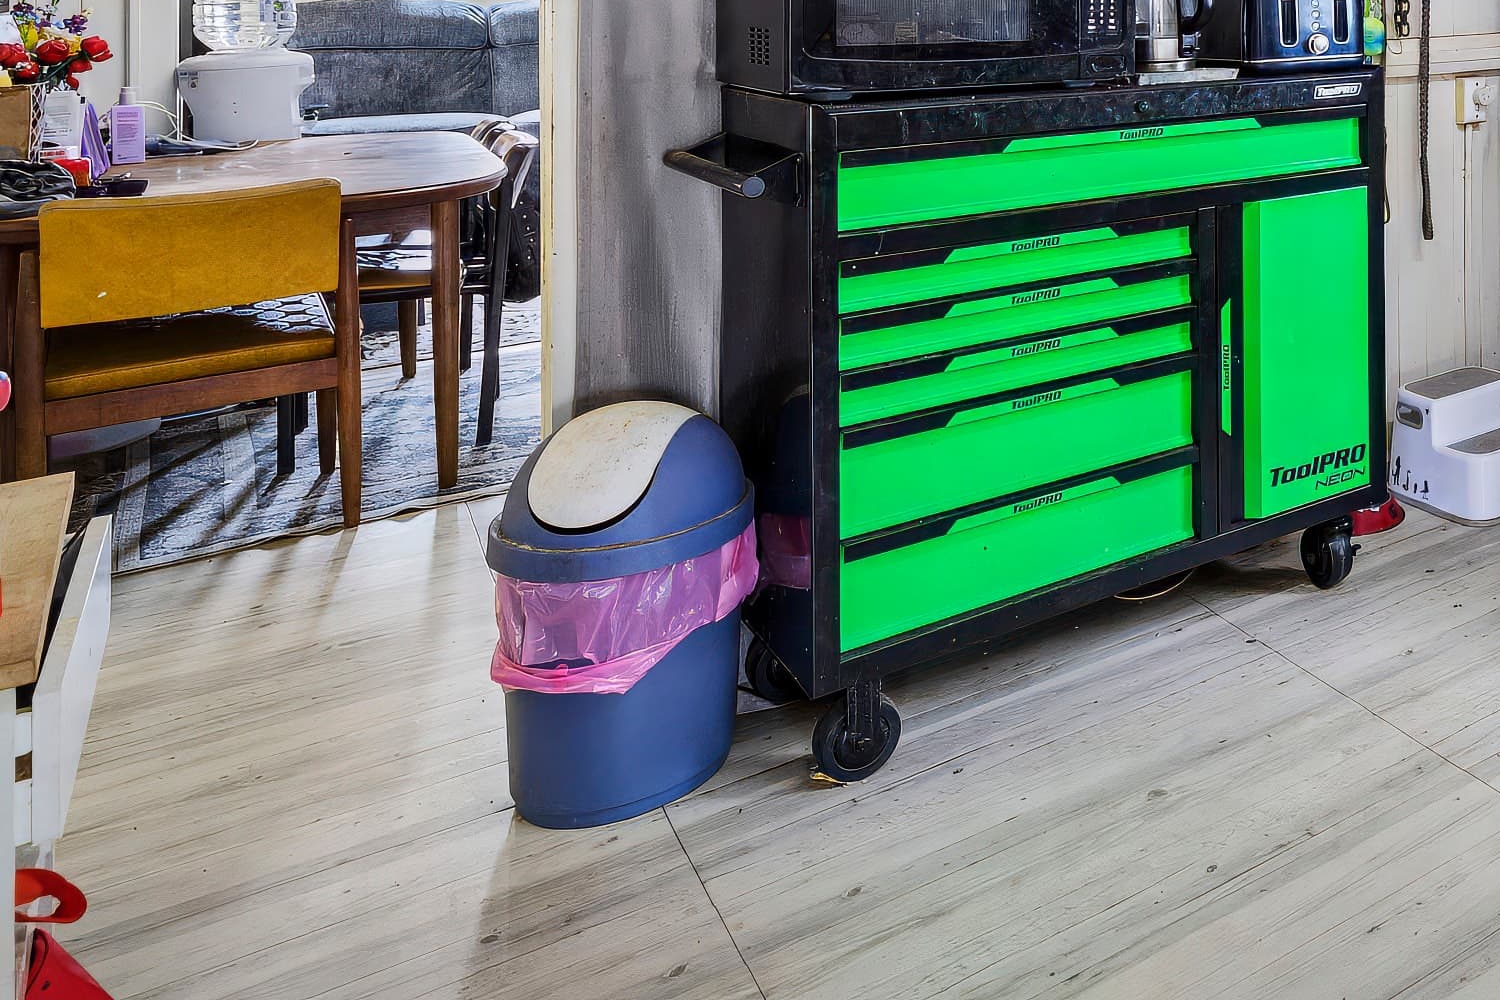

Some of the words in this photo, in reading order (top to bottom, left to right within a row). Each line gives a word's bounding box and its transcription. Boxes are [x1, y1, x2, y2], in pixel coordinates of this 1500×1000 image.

[1011, 236, 1060, 252] ToolPRO
[1011, 287, 1061, 305] ToolPRO
[1011, 339, 1061, 357] ToolPRO
[1012, 391, 1062, 410] ToolPRO
[1270, 443, 1366, 488] ToolPRO
[1315, 465, 1366, 490] NEON
[1013, 492, 1063, 514] ToolPRO
